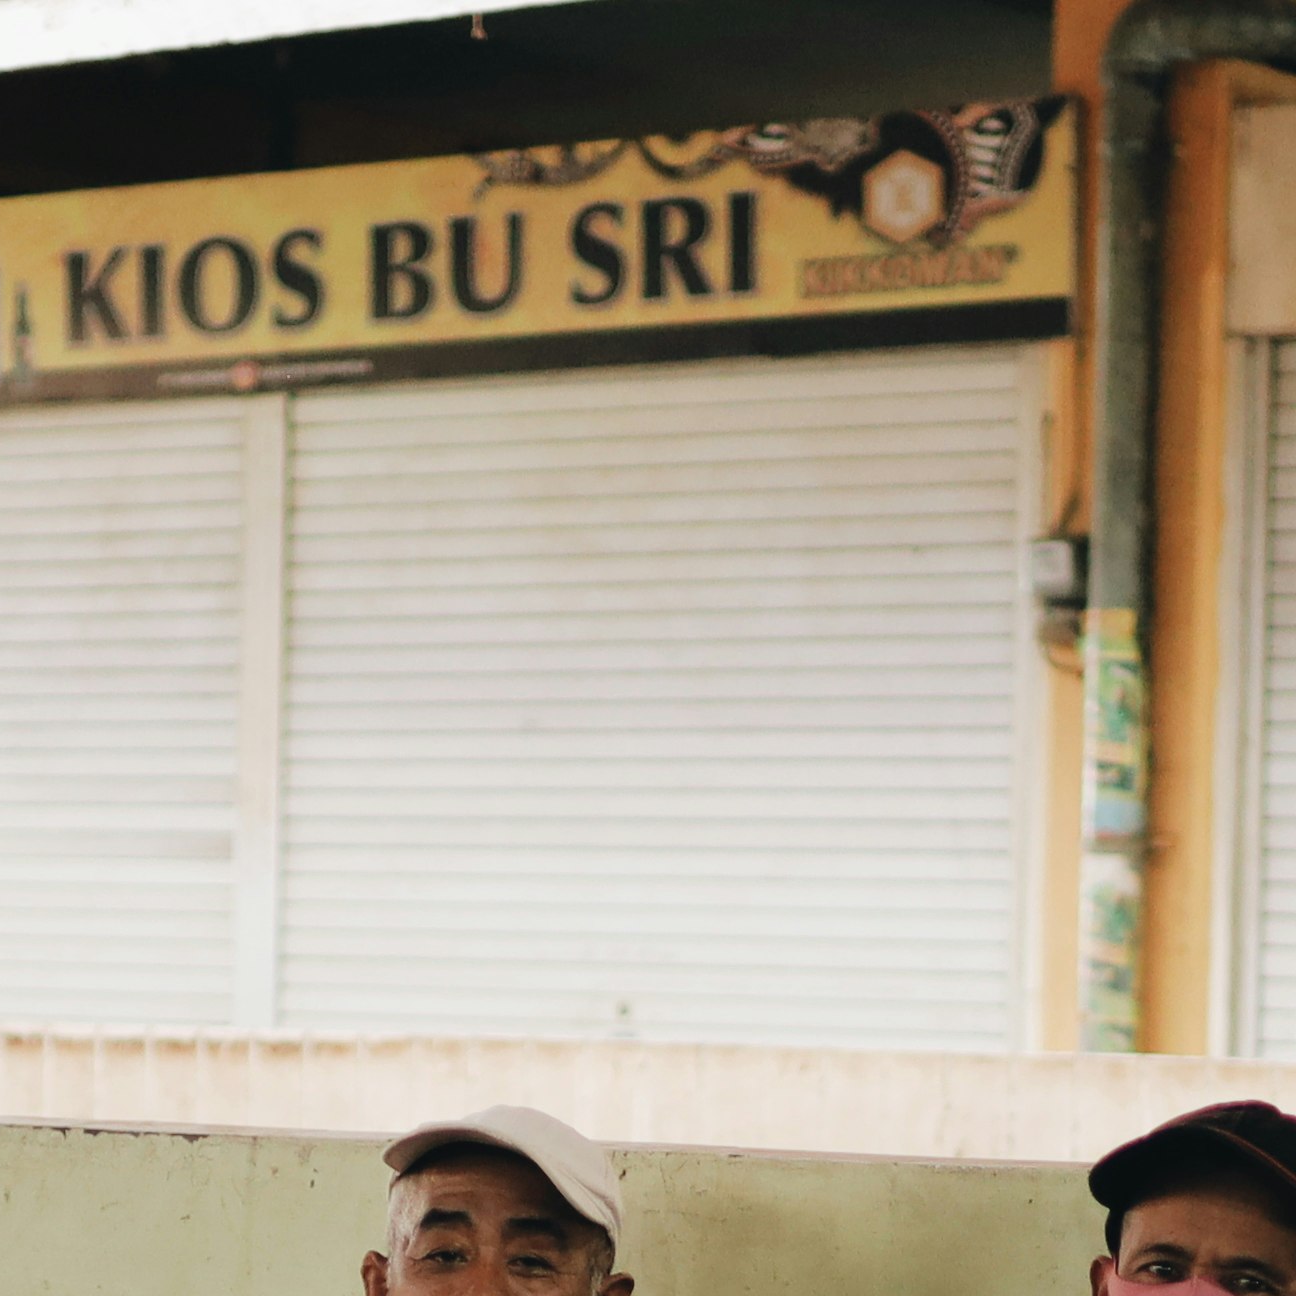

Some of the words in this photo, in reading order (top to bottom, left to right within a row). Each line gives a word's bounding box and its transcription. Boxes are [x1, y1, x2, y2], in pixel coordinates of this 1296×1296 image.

[65, 229, 324, 344] KIOS
[371, 212, 523, 319] BU
[570, 191, 757, 306] SRI
